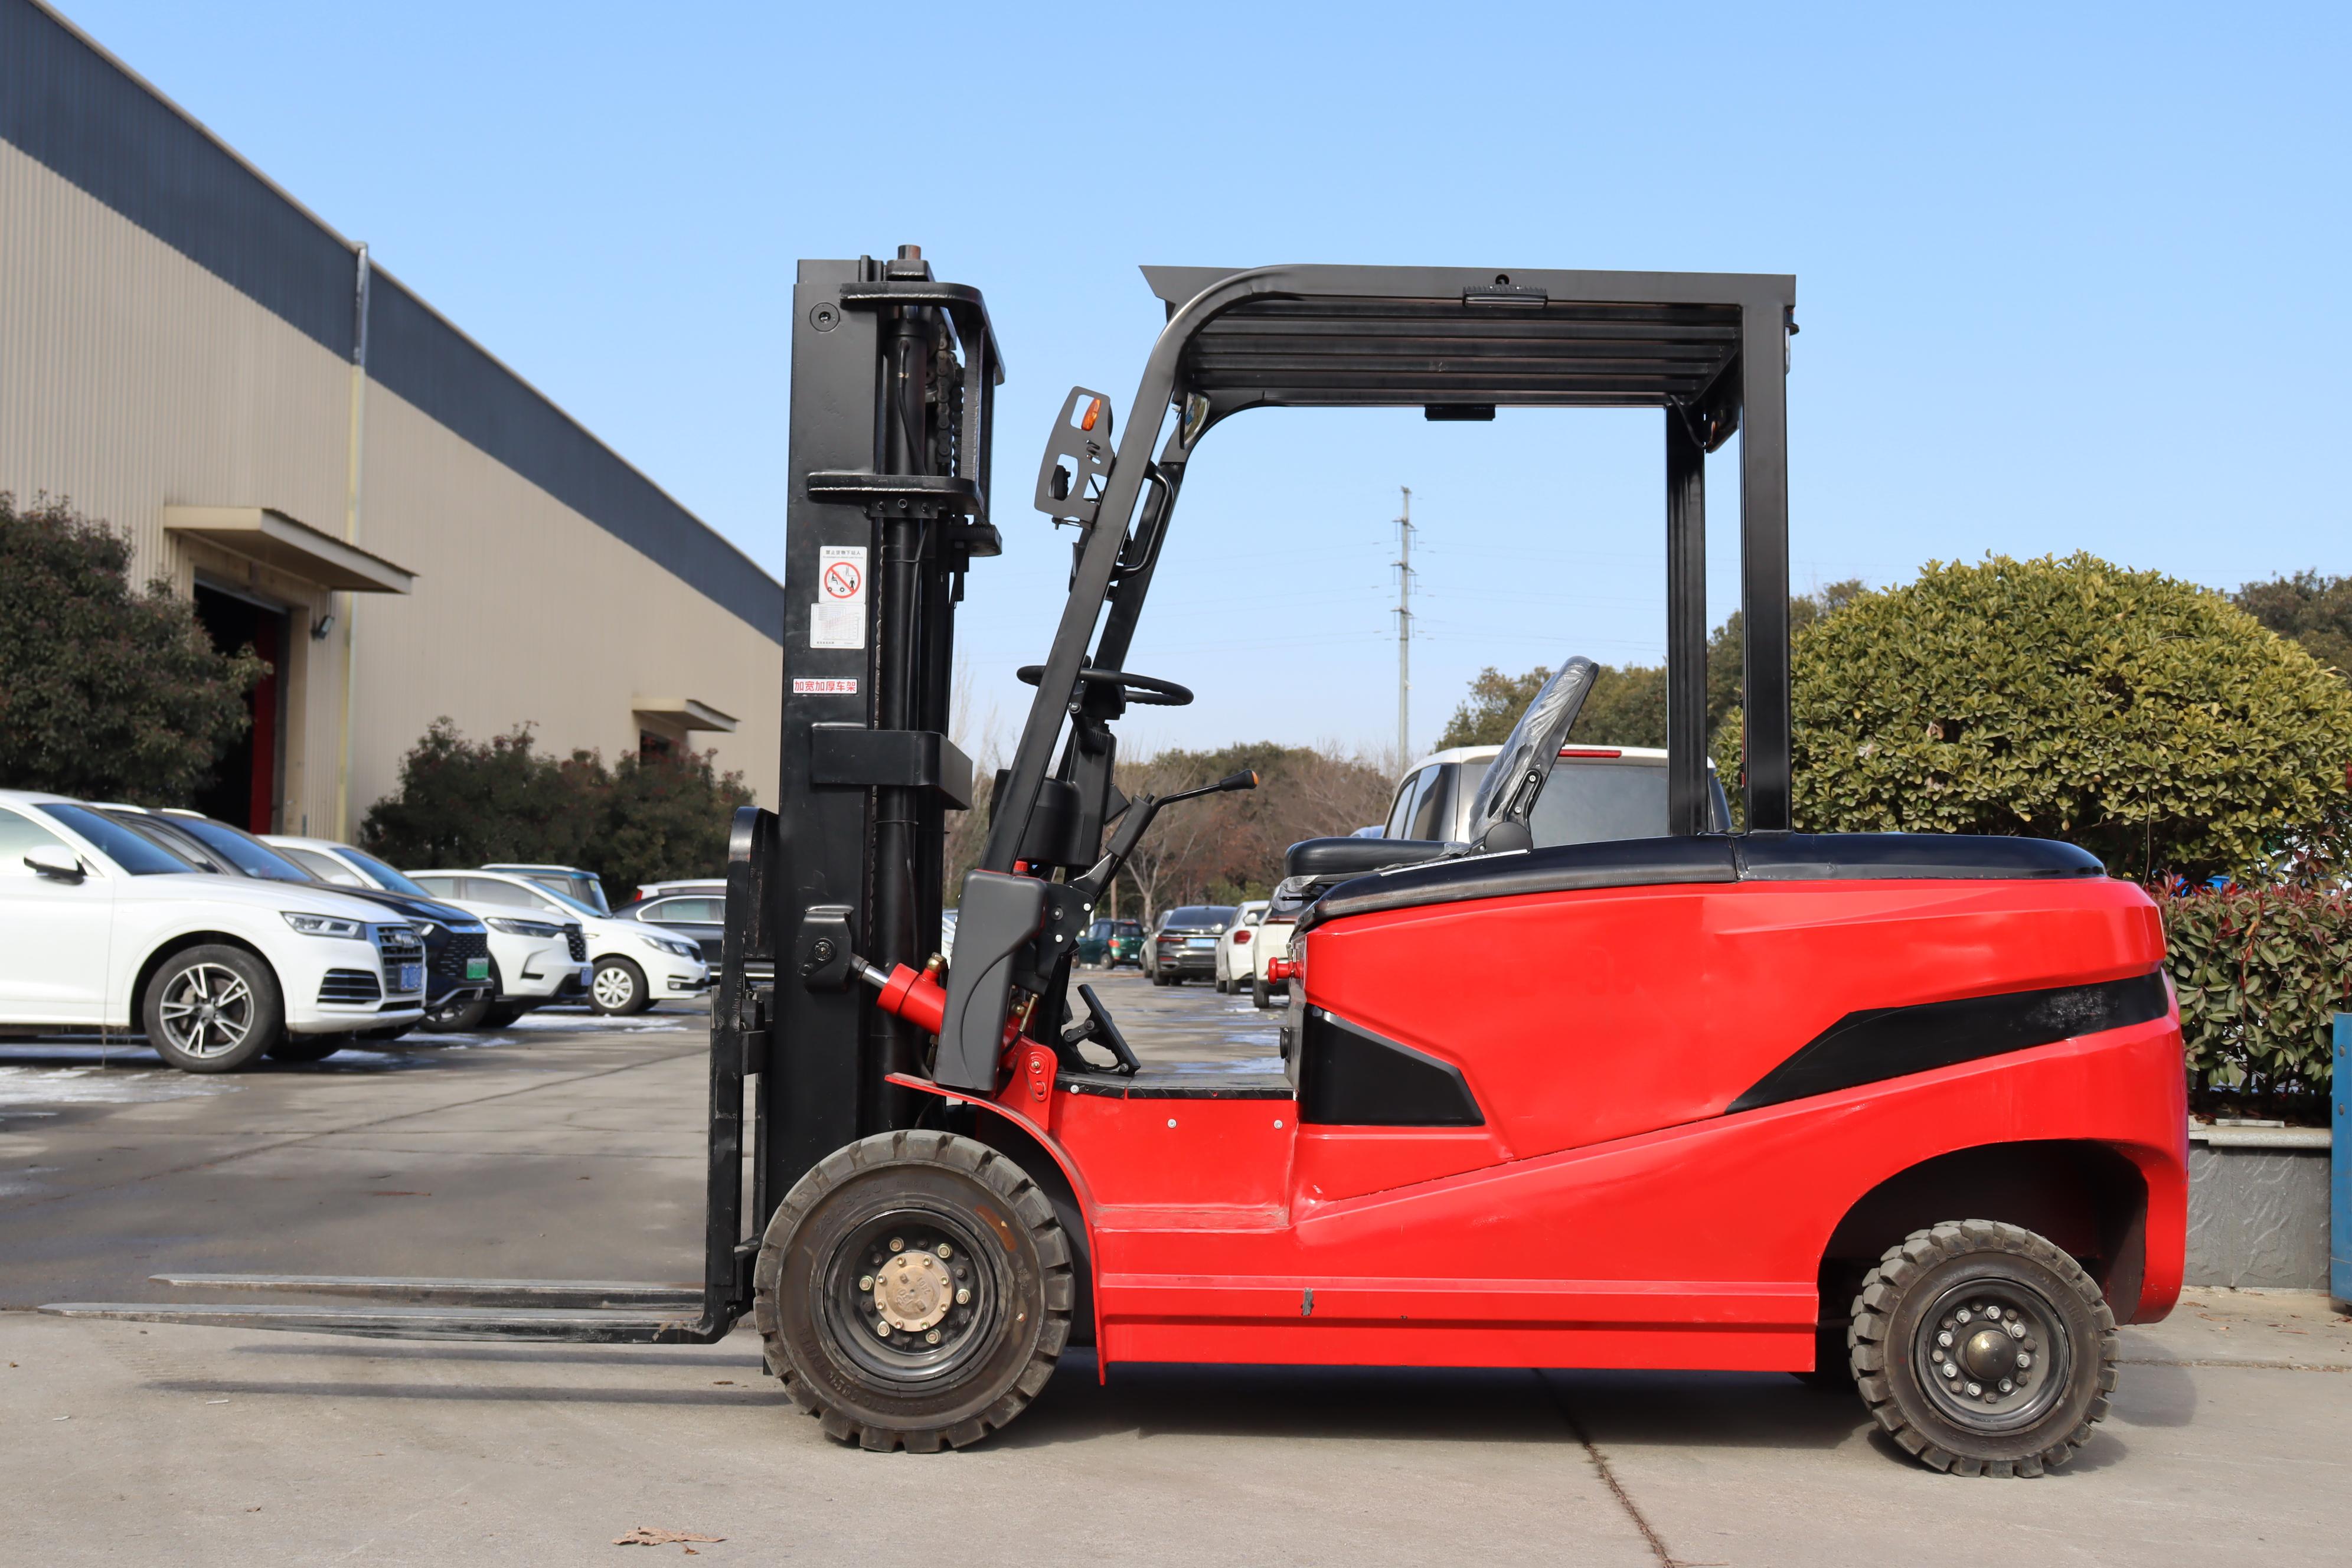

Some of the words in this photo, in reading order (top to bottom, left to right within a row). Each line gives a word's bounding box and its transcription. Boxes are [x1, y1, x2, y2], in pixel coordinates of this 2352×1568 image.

[794, 681, 856, 692] 加宽加厚车架
